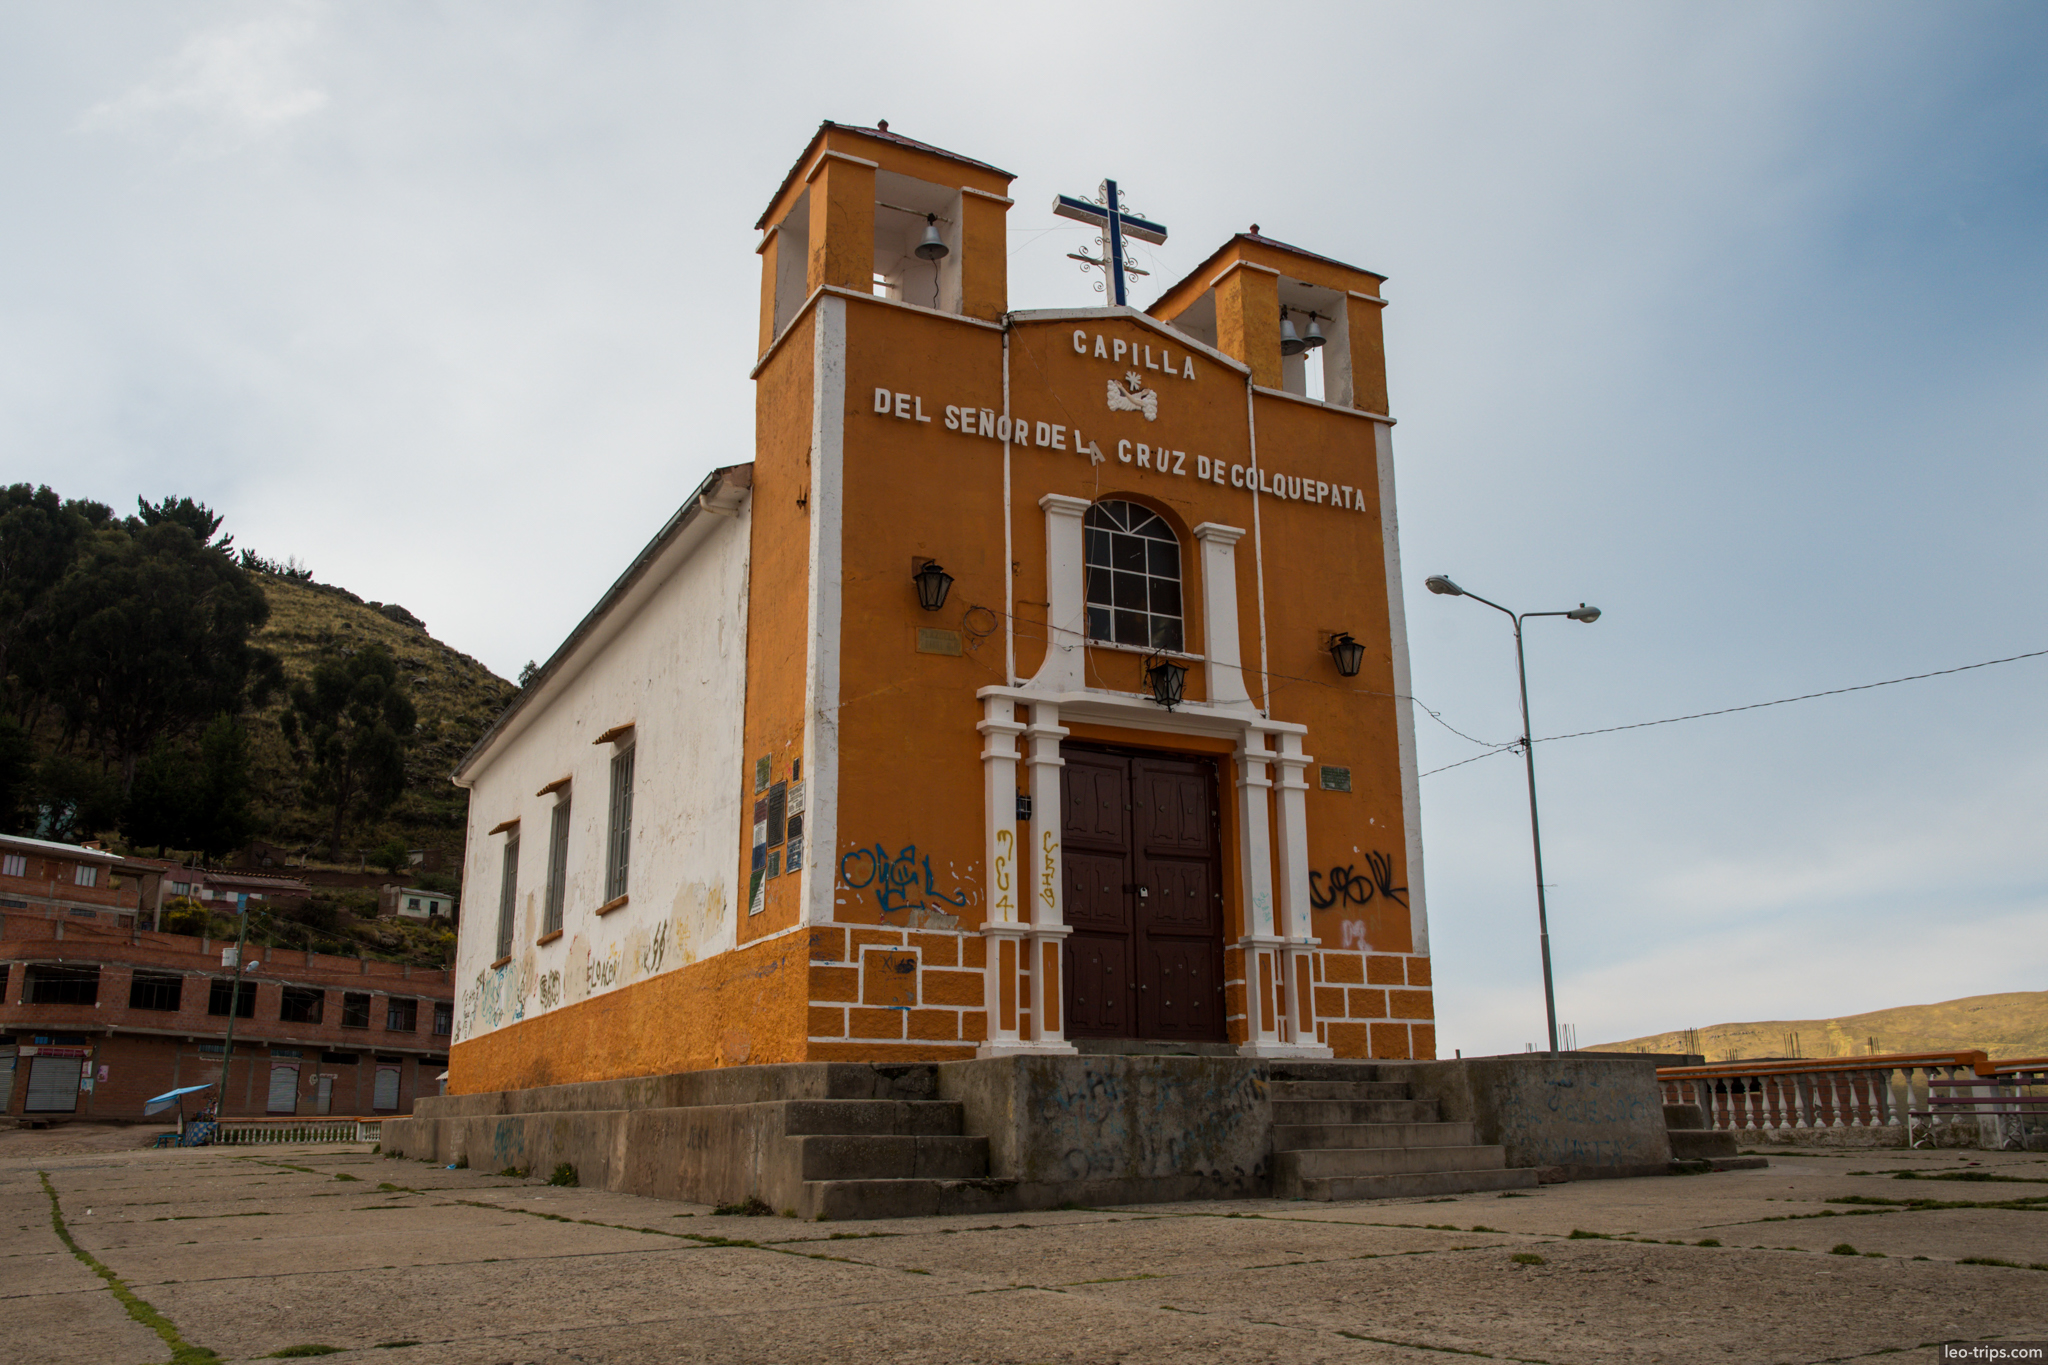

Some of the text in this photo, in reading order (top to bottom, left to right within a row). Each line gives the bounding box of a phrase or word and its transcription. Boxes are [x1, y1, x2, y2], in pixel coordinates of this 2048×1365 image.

[1073, 330, 1196, 380] CAPILLA
[874, 387, 1367, 513] DEL SEÑOR DE LA CRUZ DE COLQUEPATA
